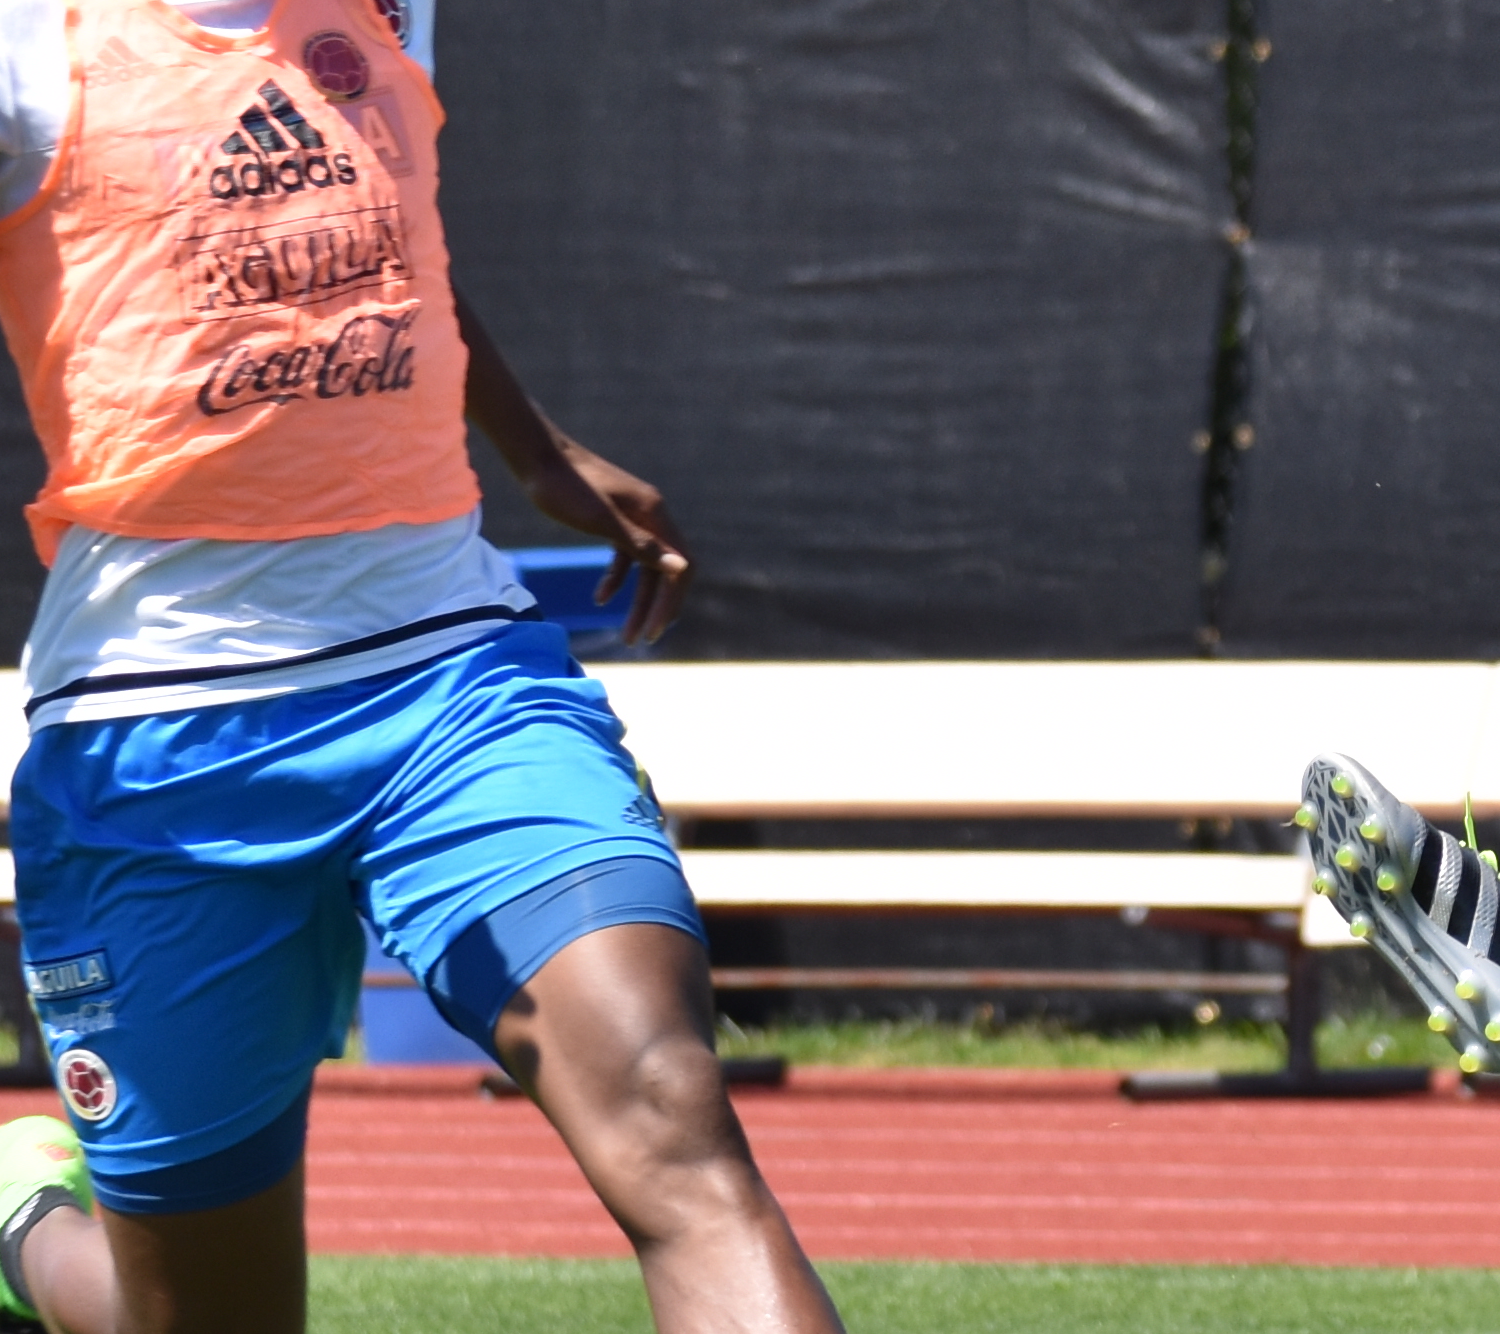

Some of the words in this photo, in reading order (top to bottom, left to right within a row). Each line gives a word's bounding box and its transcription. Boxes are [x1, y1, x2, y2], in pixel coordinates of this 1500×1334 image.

[209, 147, 358, 200] adidas
[197, 312, 420, 417] Coca-Cola
[28, 958, 105, 994] AGUILA
